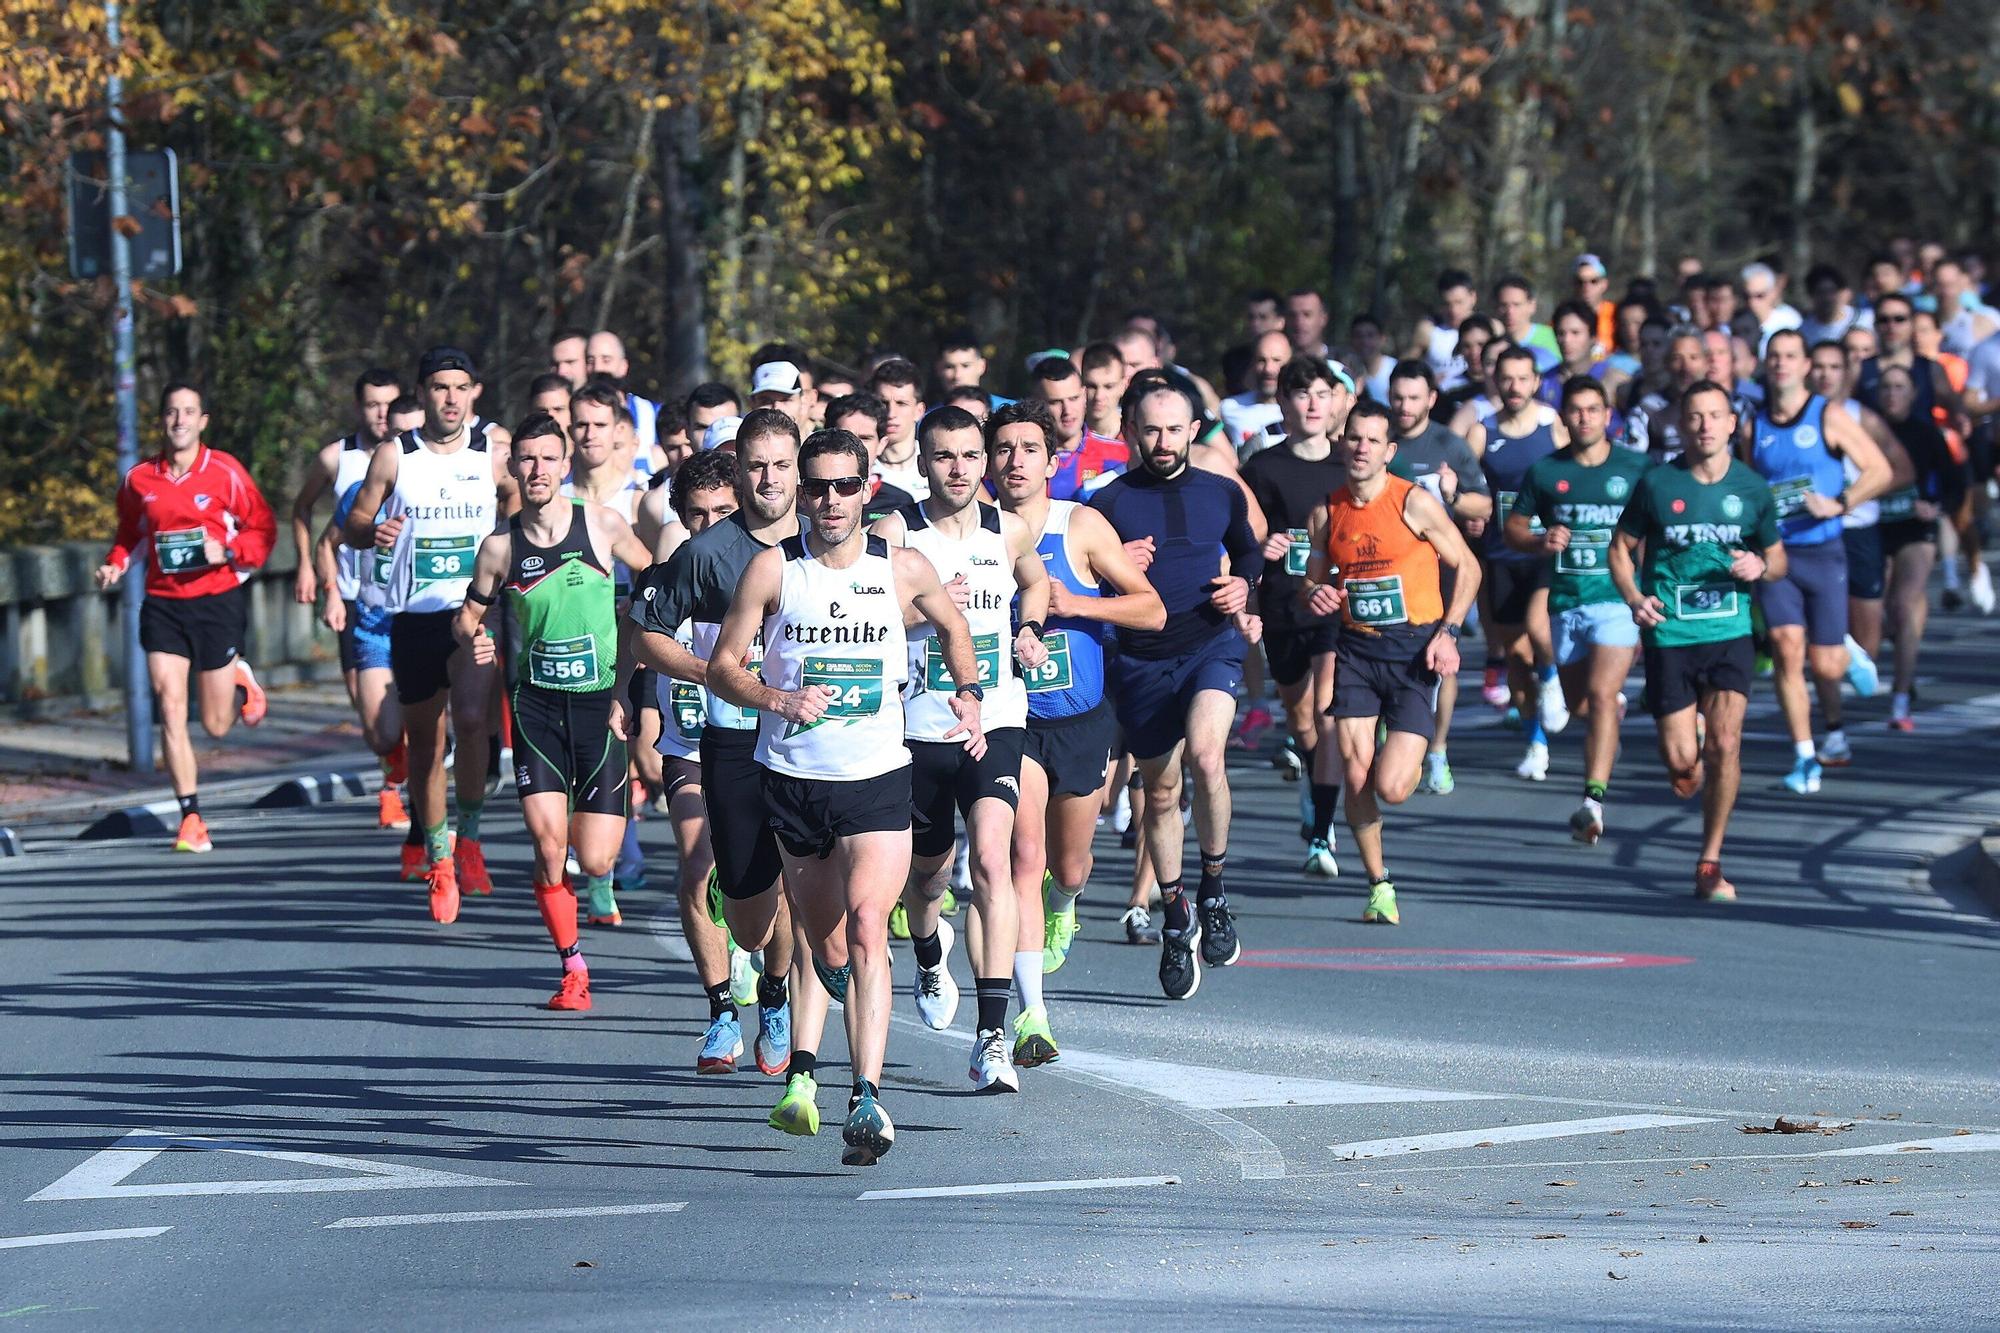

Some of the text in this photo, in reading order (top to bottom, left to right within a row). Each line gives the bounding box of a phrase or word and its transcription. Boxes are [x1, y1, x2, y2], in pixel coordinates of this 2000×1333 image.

[406, 502, 484, 520] etxenike
[431, 555, 461, 574] 36
[972, 558, 999, 566] LUGA
[1571, 548, 1597, 567] 13
[853, 586, 886, 595] LUGA
[1694, 590, 1722, 610] 38
[1356, 597, 1393, 617] 661
[784, 621, 889, 644] etxenike
[541, 660, 587, 679] 556
[938, 659, 991, 683] 22
[1019, 659, 1059, 682] 19
[828, 685, 862, 708] 24
